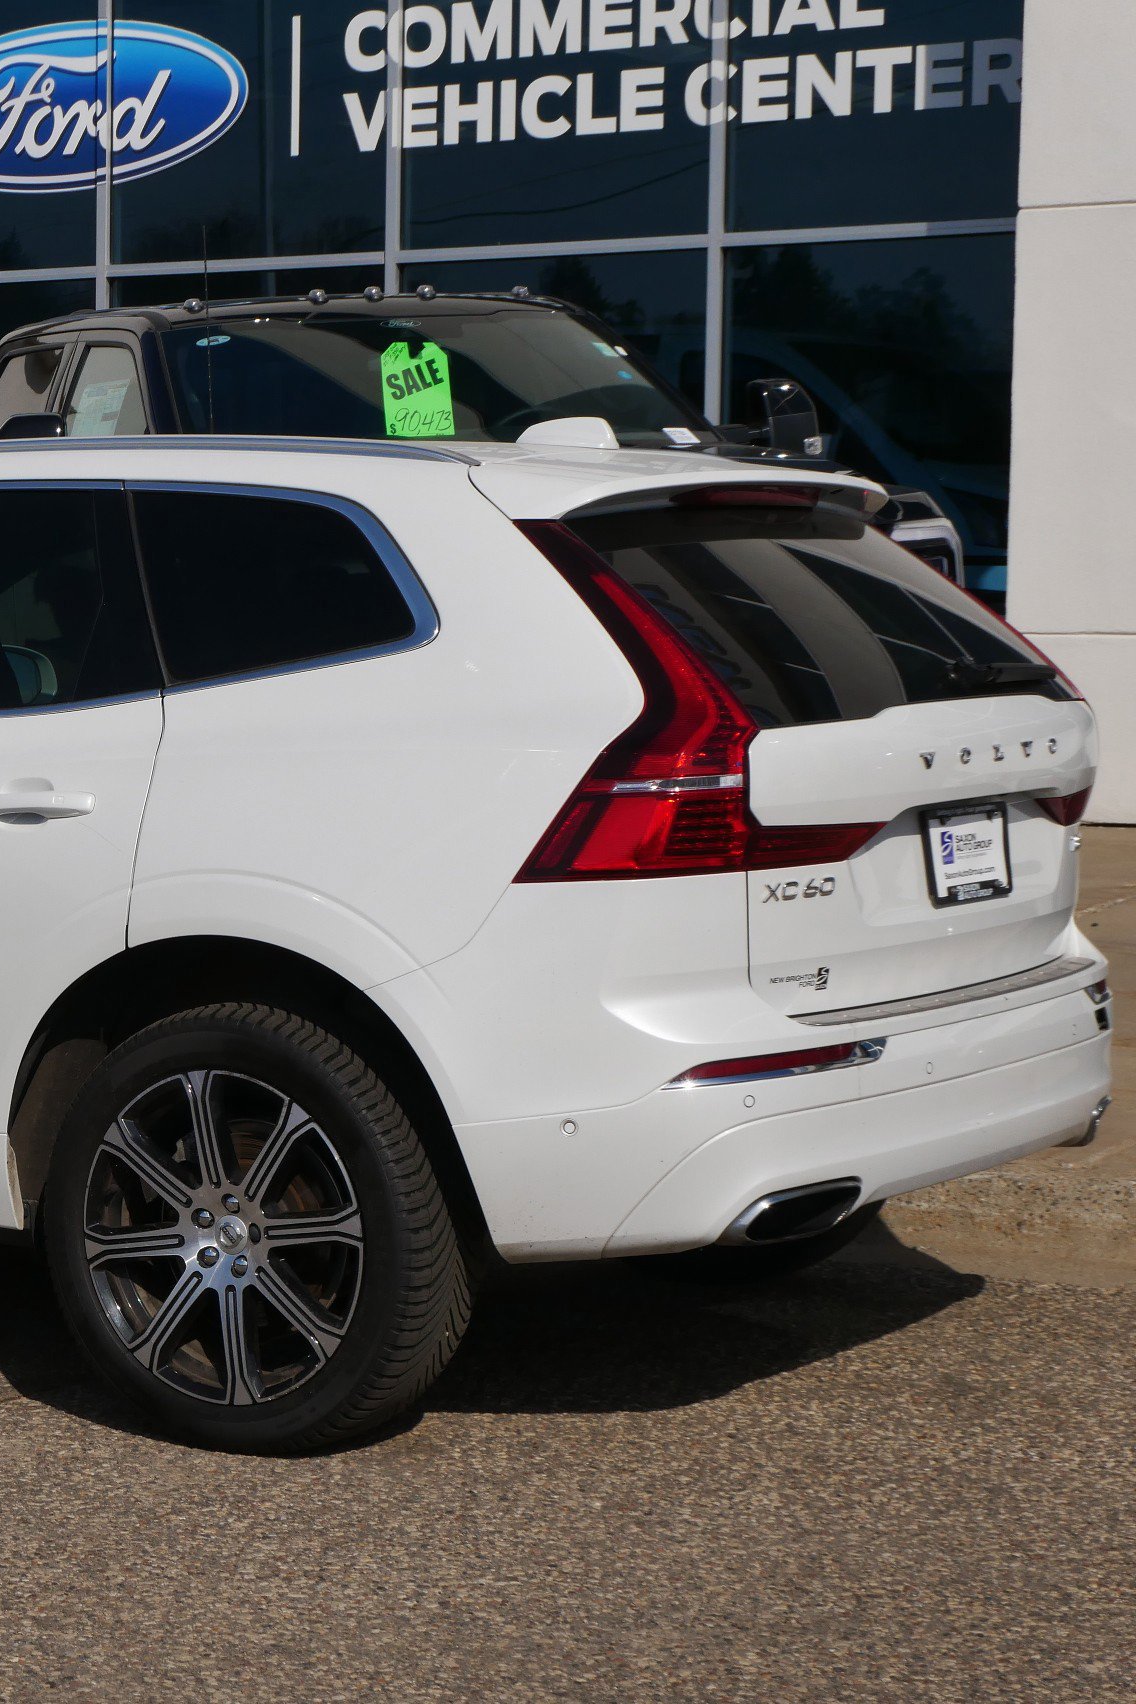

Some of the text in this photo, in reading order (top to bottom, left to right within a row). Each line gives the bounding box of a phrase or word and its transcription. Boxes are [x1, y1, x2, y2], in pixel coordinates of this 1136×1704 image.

[342, 37, 1023, 152] VEHICLE CENTER
[385, 358, 445, 401] SALE
[786, 974, 817, 983] BRIGHTON
[799, 980, 815, 988] FORD
